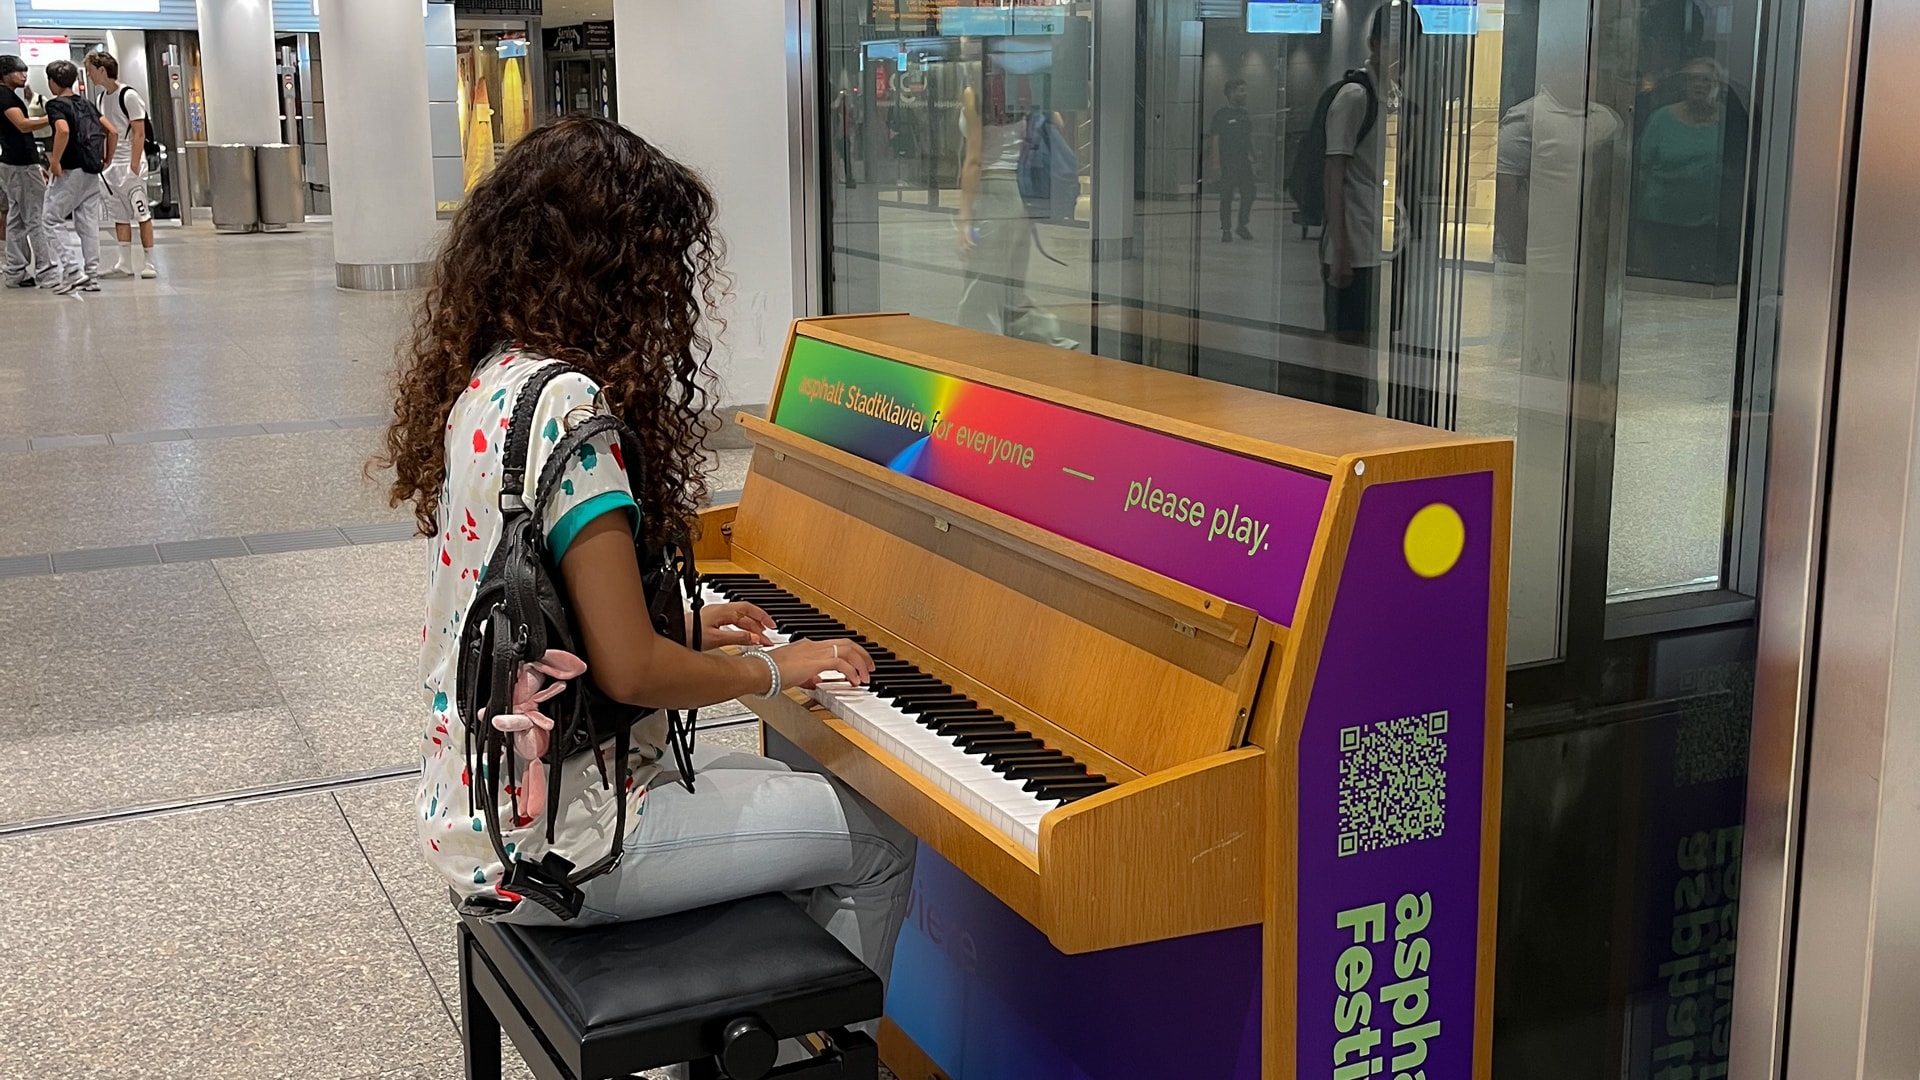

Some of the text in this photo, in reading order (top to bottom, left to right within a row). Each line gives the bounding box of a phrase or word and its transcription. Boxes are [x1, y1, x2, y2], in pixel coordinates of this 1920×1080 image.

[135, 200, 145, 213] 2
[798, 374, 845, 406] asphalt
[844, 385, 928, 433] Stadtklavier
[928, 410, 953, 441] for
[955, 424, 1035, 469] everyone
[1123, 476, 1206, 527] please
[1207, 504, 1270, 557] play.
[1332, 902, 1387, 1080] Festi
[1379, 891, 1441, 1080] asph
